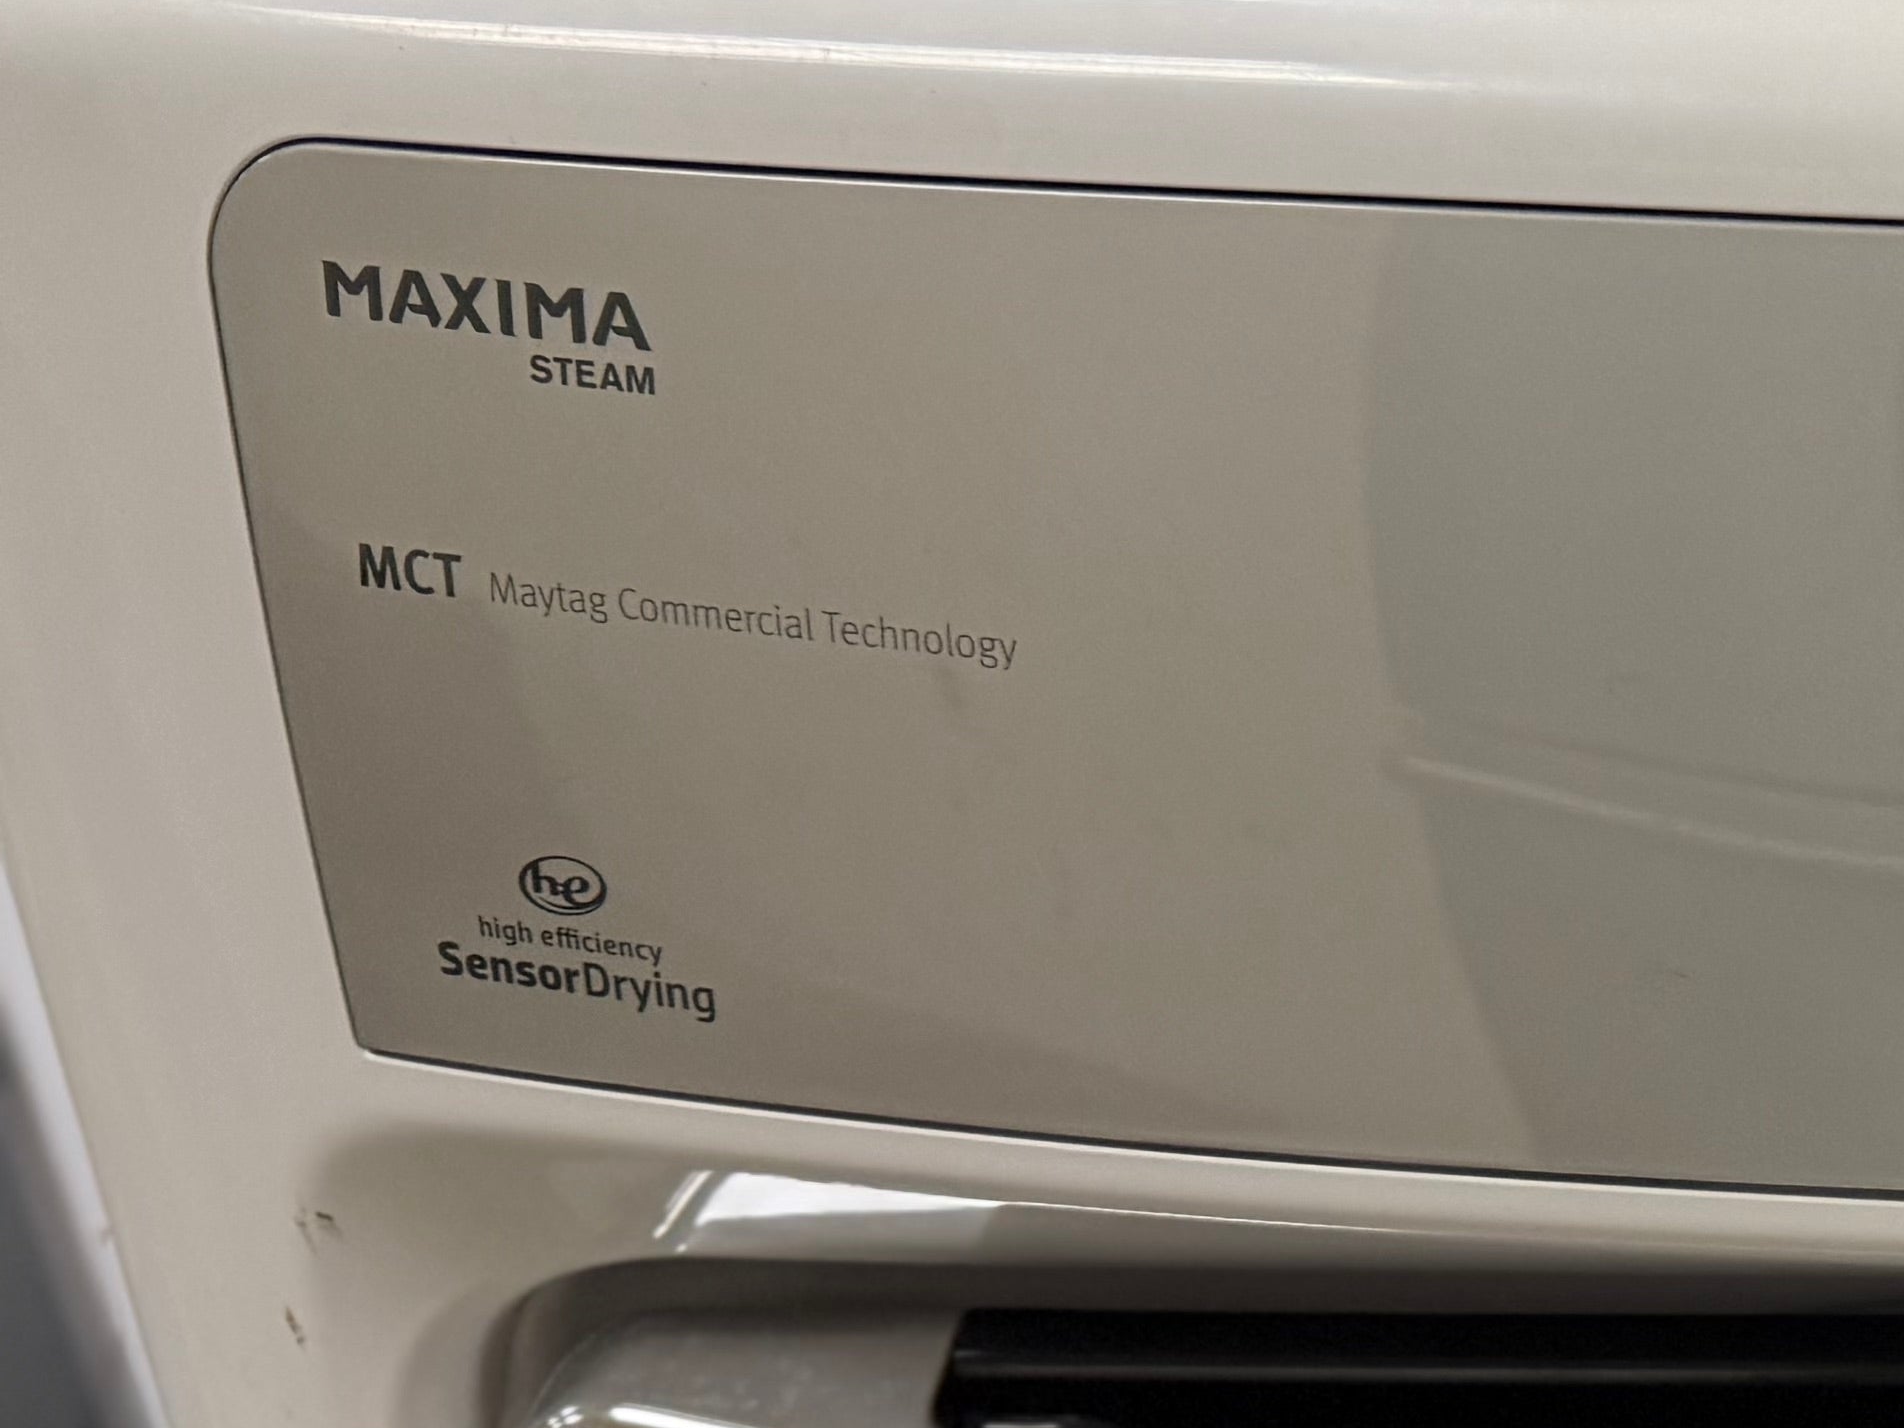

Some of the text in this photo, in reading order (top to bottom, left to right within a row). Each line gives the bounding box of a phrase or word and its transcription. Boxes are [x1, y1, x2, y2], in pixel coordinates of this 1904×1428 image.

[322, 260, 651, 351] MAXIMA
[530, 355, 655, 395] STEAM
[359, 543, 1016, 670] MCT Maytag Commercial Technology
[438, 940, 715, 1023] SensorDrying
[478, 916, 662, 968] high efficiency
